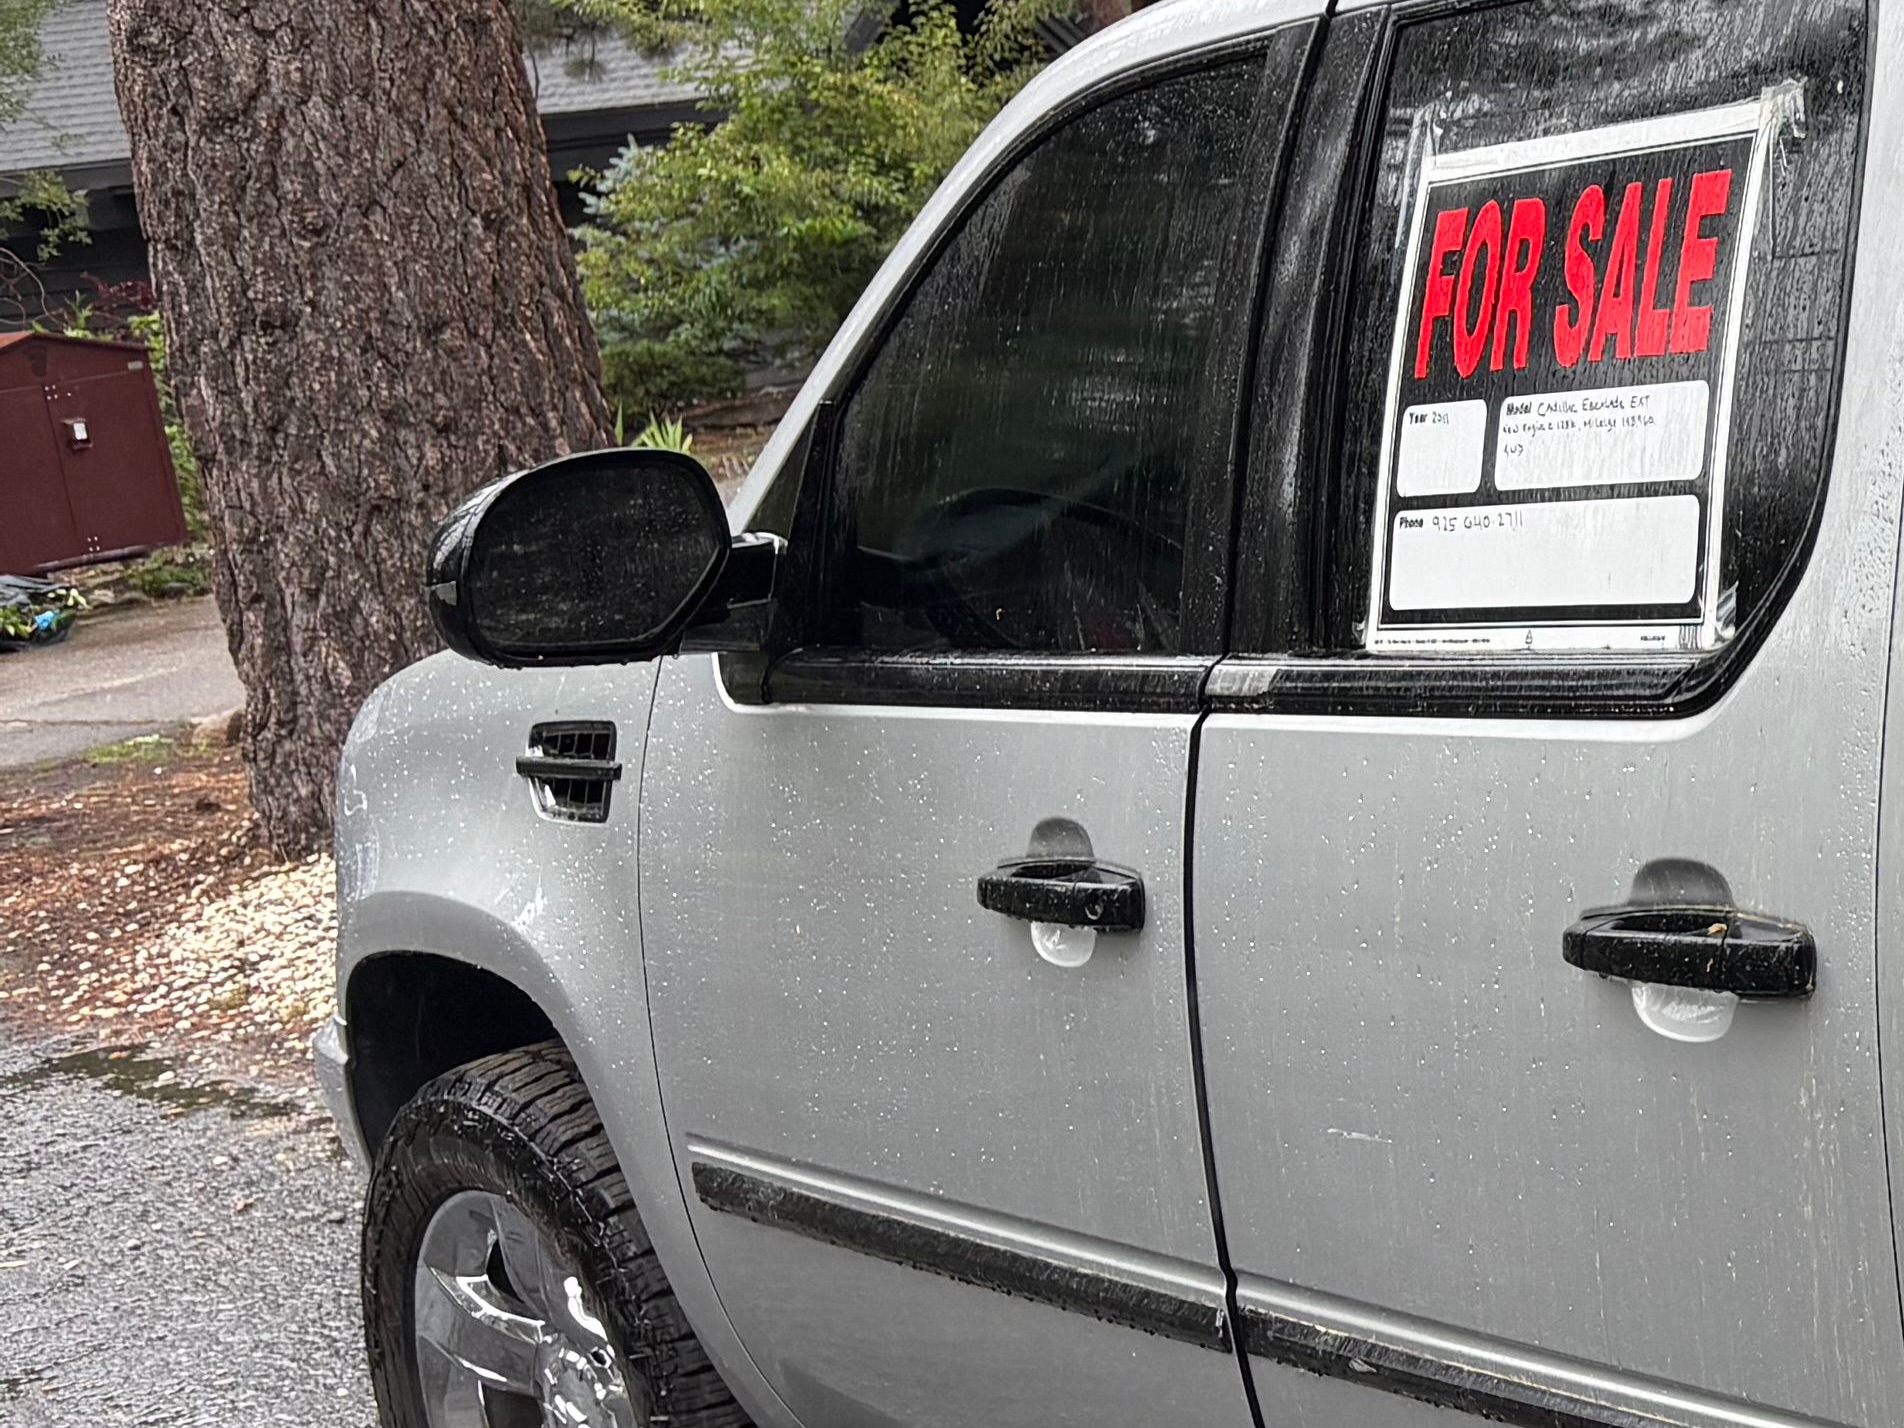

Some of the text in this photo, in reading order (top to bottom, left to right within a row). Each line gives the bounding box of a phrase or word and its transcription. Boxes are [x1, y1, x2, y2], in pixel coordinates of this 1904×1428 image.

[1414, 168, 1731, 379] FOR SALE
[1506, 400, 1532, 416] Model
[1409, 412, 1428, 425] Year
[1432, 515, 1457, 532] 925
